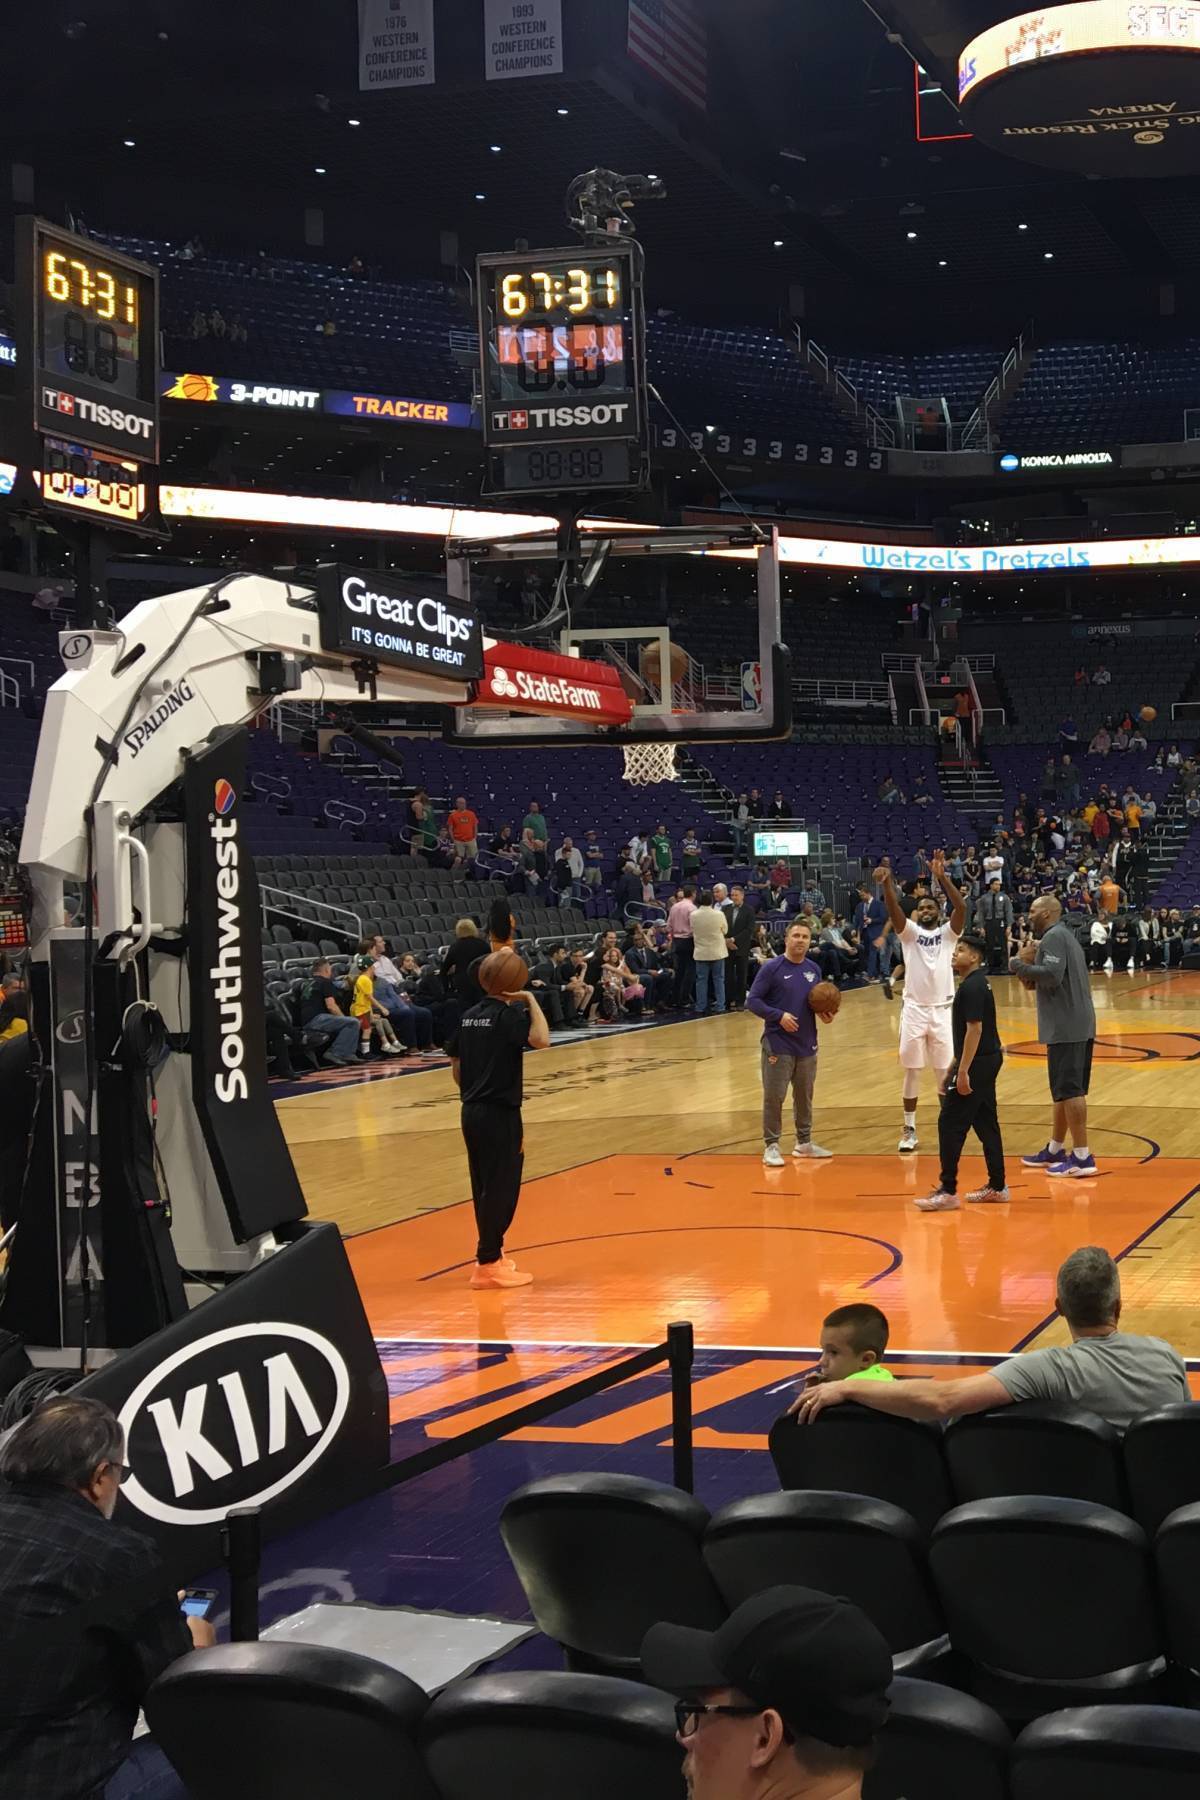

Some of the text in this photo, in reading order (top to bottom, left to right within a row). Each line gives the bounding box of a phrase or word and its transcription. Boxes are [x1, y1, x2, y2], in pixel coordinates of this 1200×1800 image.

[511, 5, 534, 18] 1993
[372, 32, 418, 48] WESTERN
[499, 20, 547, 37] WESTERN
[365, 48, 427, 66] CONFERENCE
[491, 36, 555, 55] CONFERENCE
[368, 65, 425, 82] CHAMPIONS
[495, 54, 553, 72] CHAMPIONS
[47, 252, 135, 323] 67:31
[502, 269, 616, 317] 67:31
[230, 384, 449, 422] 3-POINT TRACKER
[529, 403, 628, 428] TISSOT
[75, 397, 153, 438] TISSOT
[1021, 452, 1112, 467] KONICA MINOLTA
[861, 545, 1090, 571] Wetzel's Pretzels
[342, 576, 472, 646] Great Clips
[1087, 623, 1131, 635] annexus
[351, 626, 465, 667] IT'S GONNA BE GREAT
[123, 677, 196, 759] SPALDING
[209, 817, 249, 1103] Southwest
[146, 1352, 323, 1498] KIA
